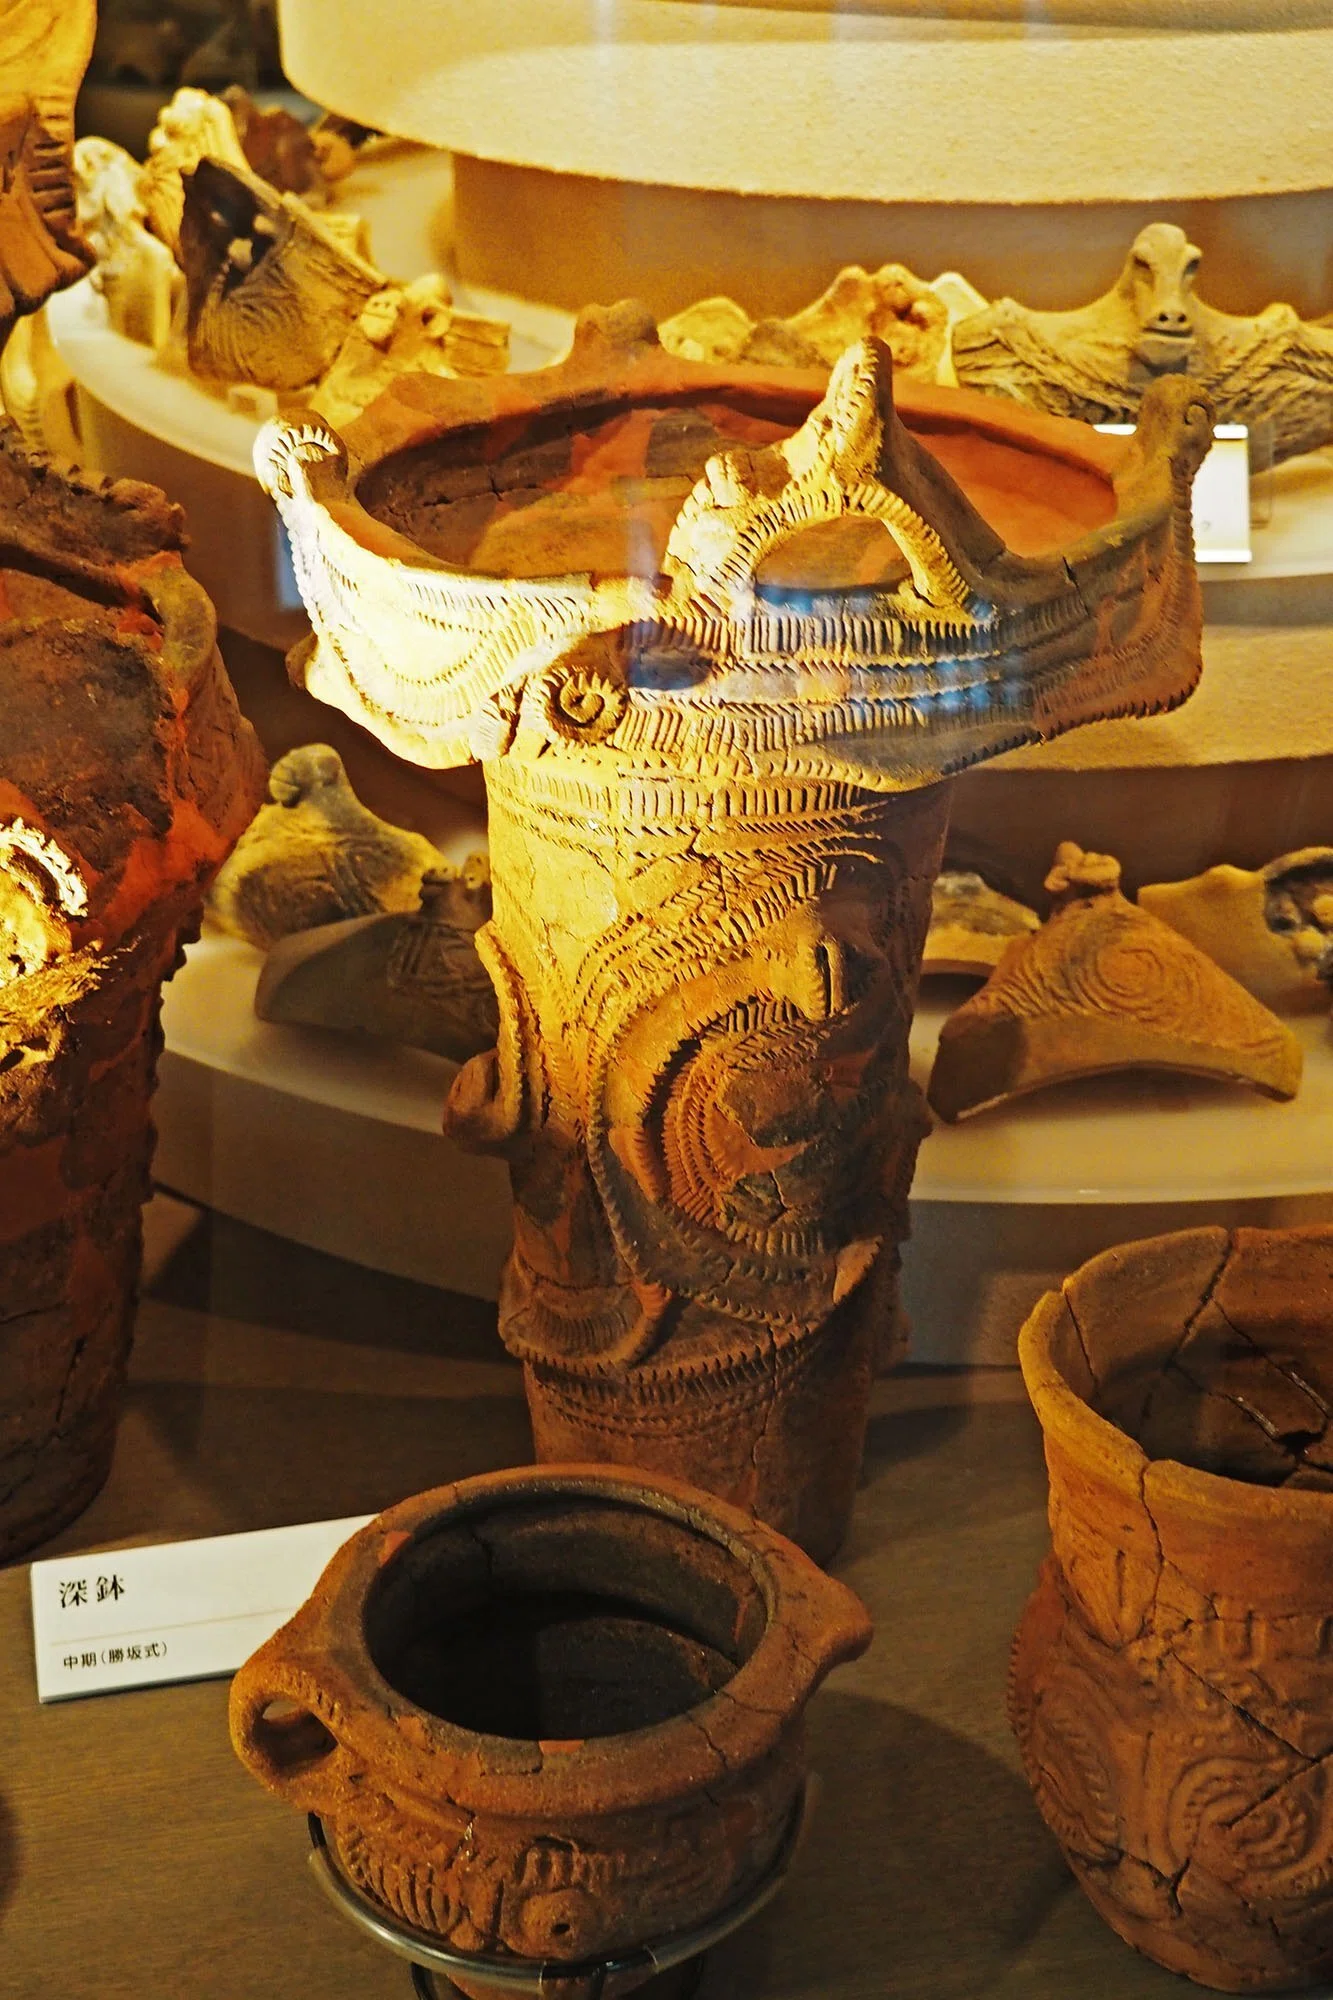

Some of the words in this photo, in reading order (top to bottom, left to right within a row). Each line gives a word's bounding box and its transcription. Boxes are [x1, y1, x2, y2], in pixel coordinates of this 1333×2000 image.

[59, 1574, 125, 1608] 深鉢
[63, 1641, 168, 1670] 中期(勝坂式)
